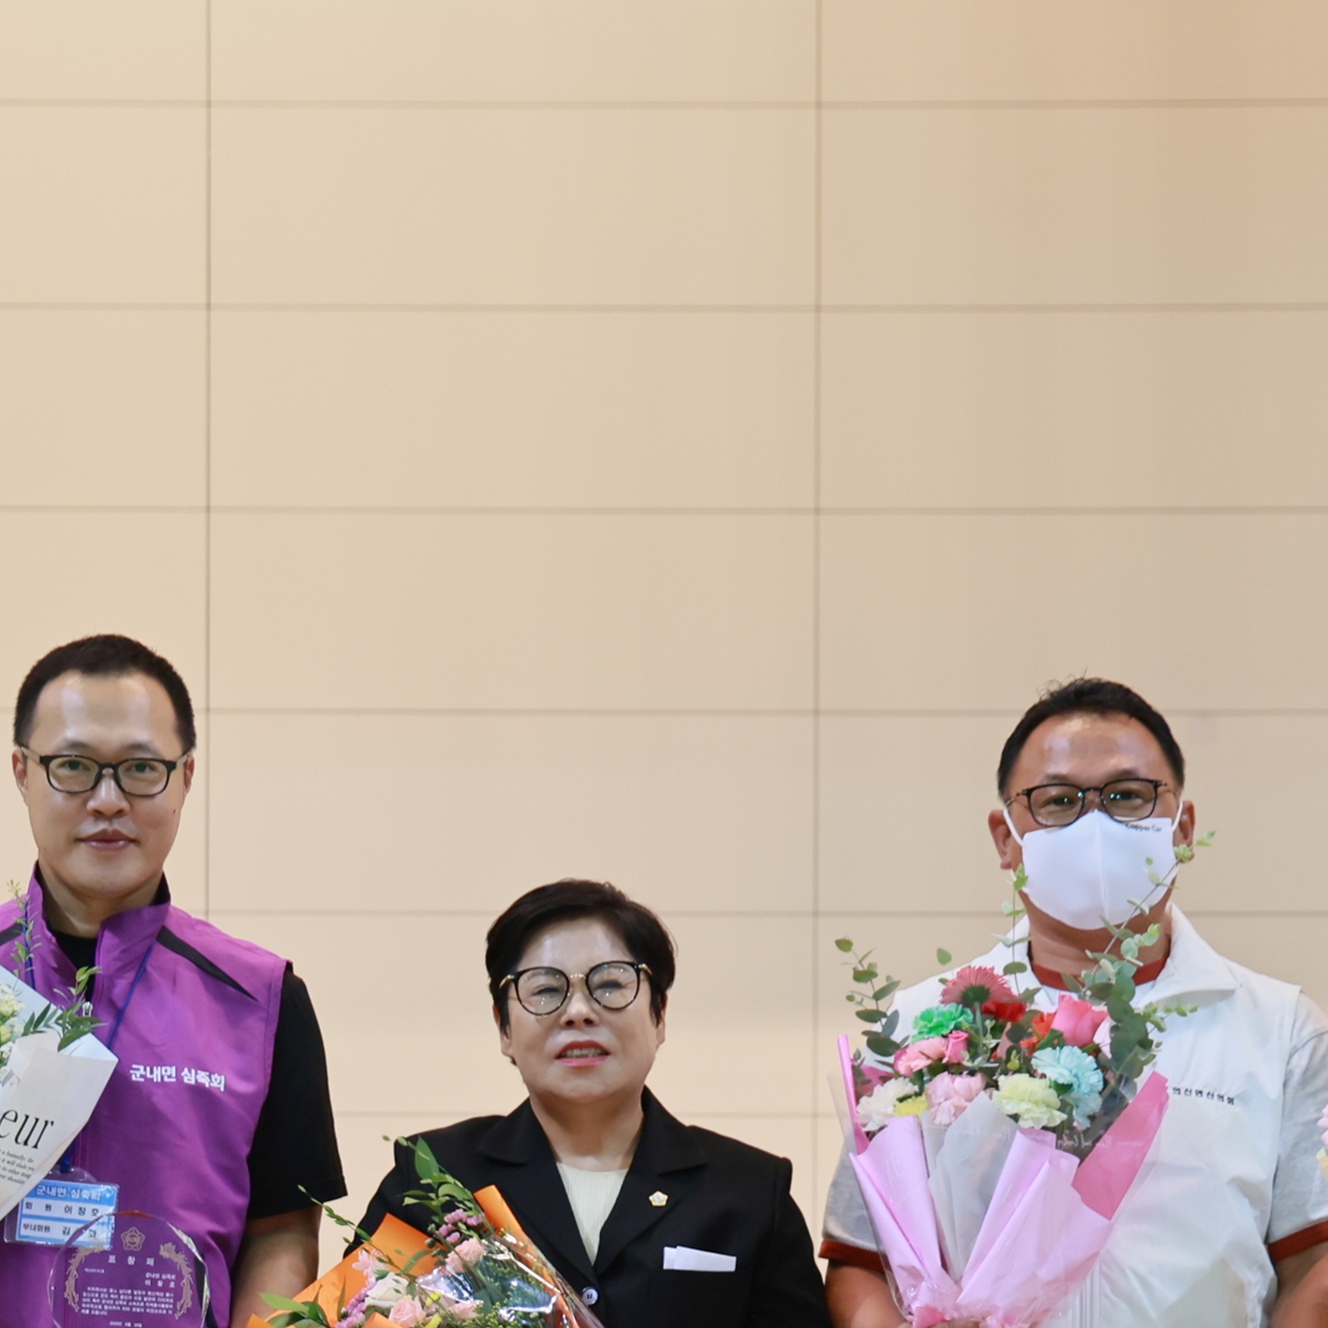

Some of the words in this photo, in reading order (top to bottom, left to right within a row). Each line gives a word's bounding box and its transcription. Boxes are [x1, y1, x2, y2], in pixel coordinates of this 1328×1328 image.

[130, 1064, 176, 1082] 군내면
[181, 1067, 225, 1092] 심죽회
[36, 1184, 67, 1197] 군내면
